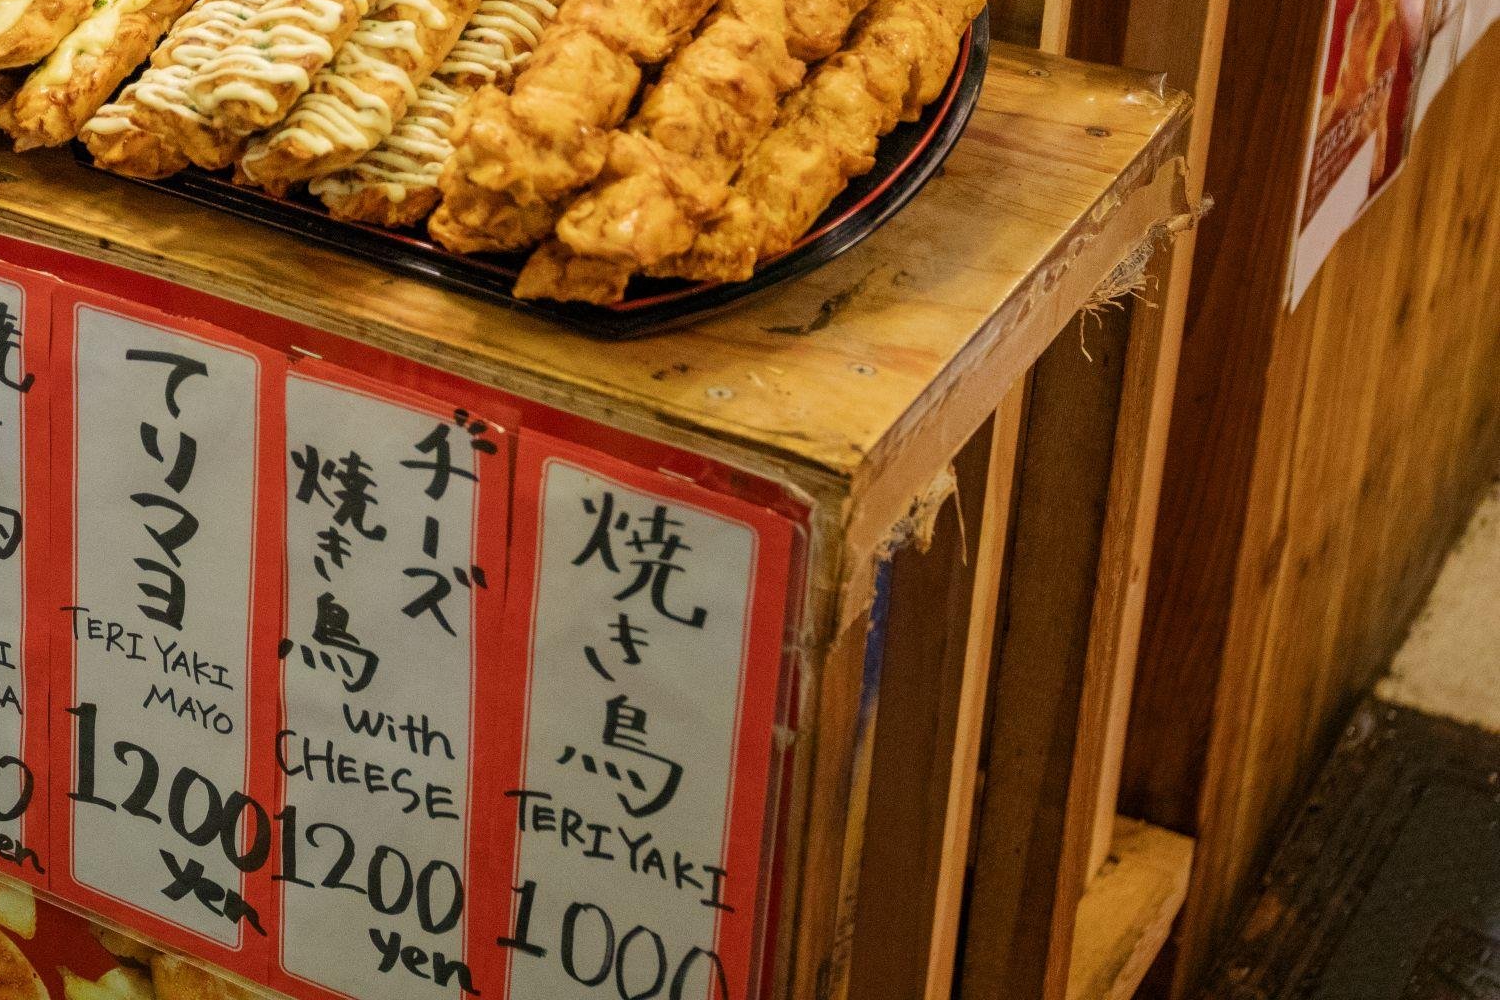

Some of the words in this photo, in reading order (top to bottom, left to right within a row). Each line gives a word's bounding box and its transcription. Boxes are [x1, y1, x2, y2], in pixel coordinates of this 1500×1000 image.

[125, 348, 209, 632] てりマヨ
[277, 443, 388, 694] 焼き鳥
[399, 412, 492, 638] チーズ
[142, 683, 235, 736] MAYO
[555, 491, 710, 820] 焼き鳥
[64, 702, 273, 873] 1200
[274, 729, 460, 820] CHEESE
[503, 789, 736, 914] TERIYAKI
[158, 847, 269, 937] yen
[270, 804, 466, 935] 1200
[368, 928, 482, 997] yen
[495, 879, 731, 1000] 1000
